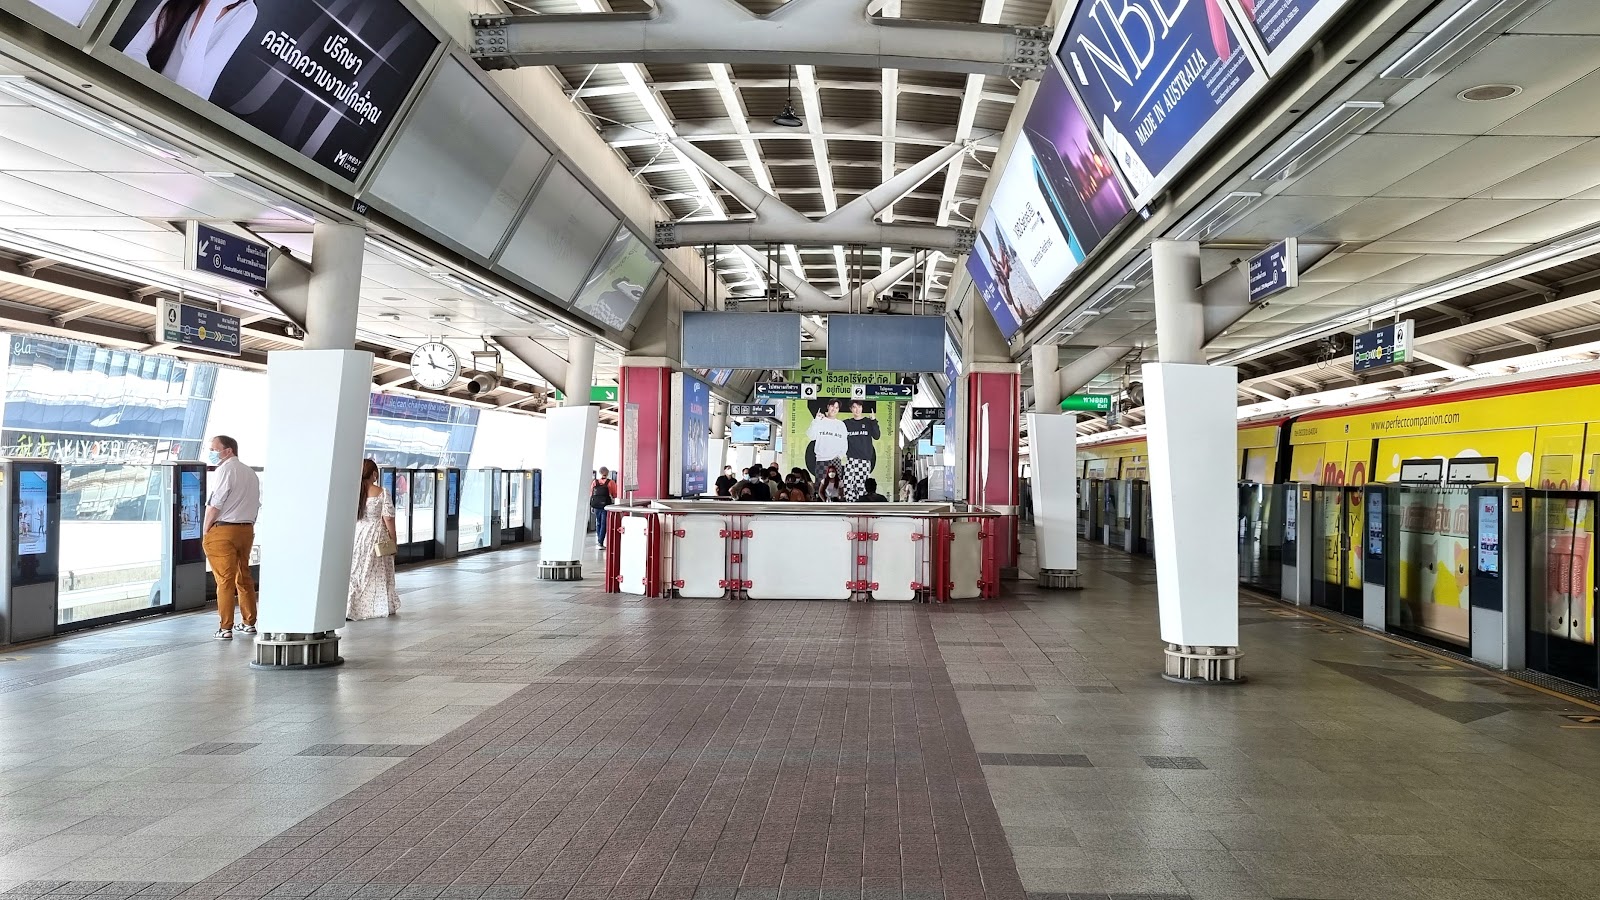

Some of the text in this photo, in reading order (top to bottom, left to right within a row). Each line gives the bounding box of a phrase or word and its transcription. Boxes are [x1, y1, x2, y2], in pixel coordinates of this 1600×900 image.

[260, 30, 382, 125] คลินิกความงามใกล้คุณ
[323, 34, 363, 75] ปรึกษา
[1134, 48, 1208, 147] MADE IN AUSTRALIA
[1371, 411, 1460, 432] www.perfectcompanion.com
